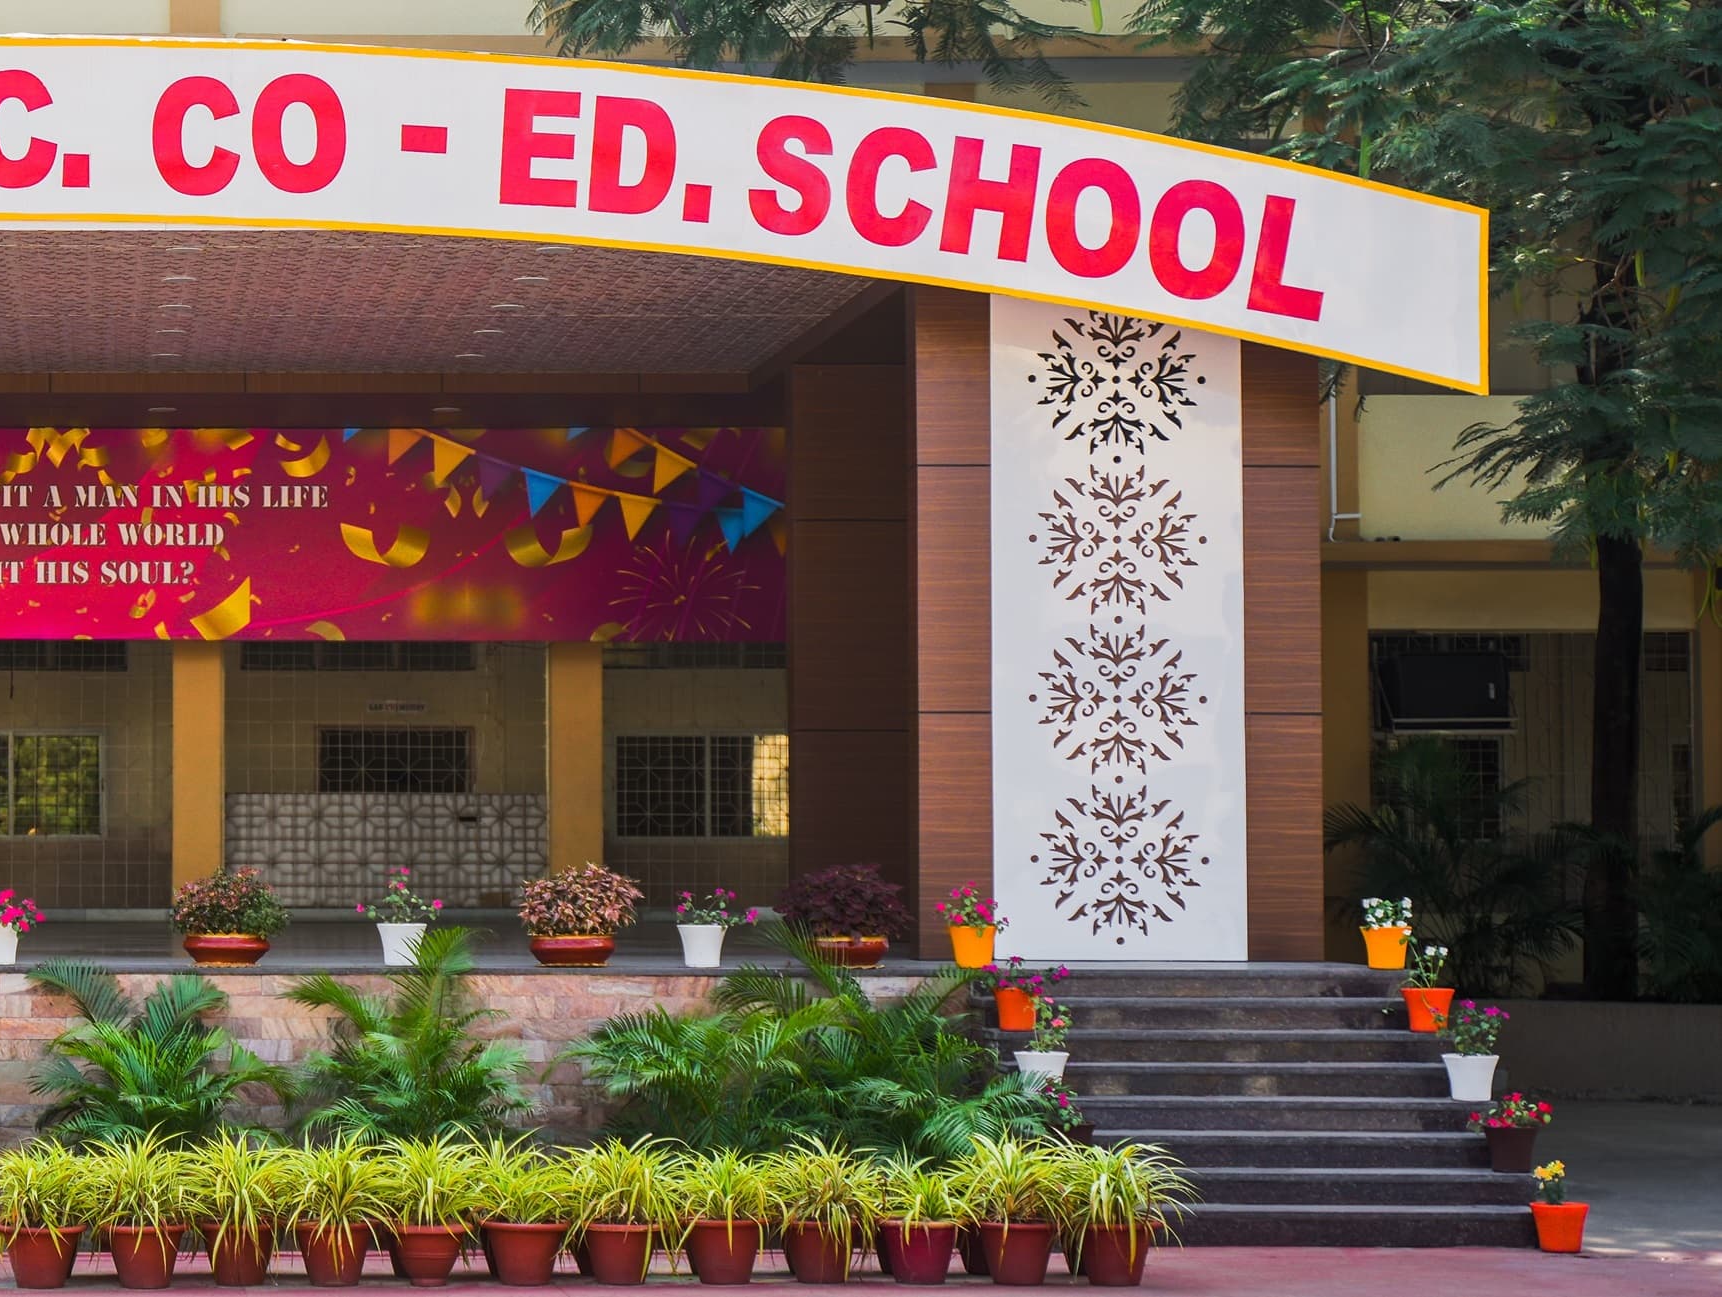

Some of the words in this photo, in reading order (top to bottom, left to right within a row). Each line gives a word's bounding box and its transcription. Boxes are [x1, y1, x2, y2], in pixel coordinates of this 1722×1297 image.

[152, 73, 347, 197] CO
[400, 124, 448, 154] -
[499, 88, 712, 224] ED.
[748, 115, 1324, 321] SCHOOL
[42, 485, 63, 508] A
[74, 485, 138, 508] MAN
[152, 485, 184, 508] IN
[196, 485, 251, 508] HIS
[261, 485, 329, 508] LIFE
[0, 522, 107, 546] WHOLE
[117, 522, 225, 547] WORLD
[35, 560, 90, 584] HIS
[100, 560, 196, 585] SOUL?
